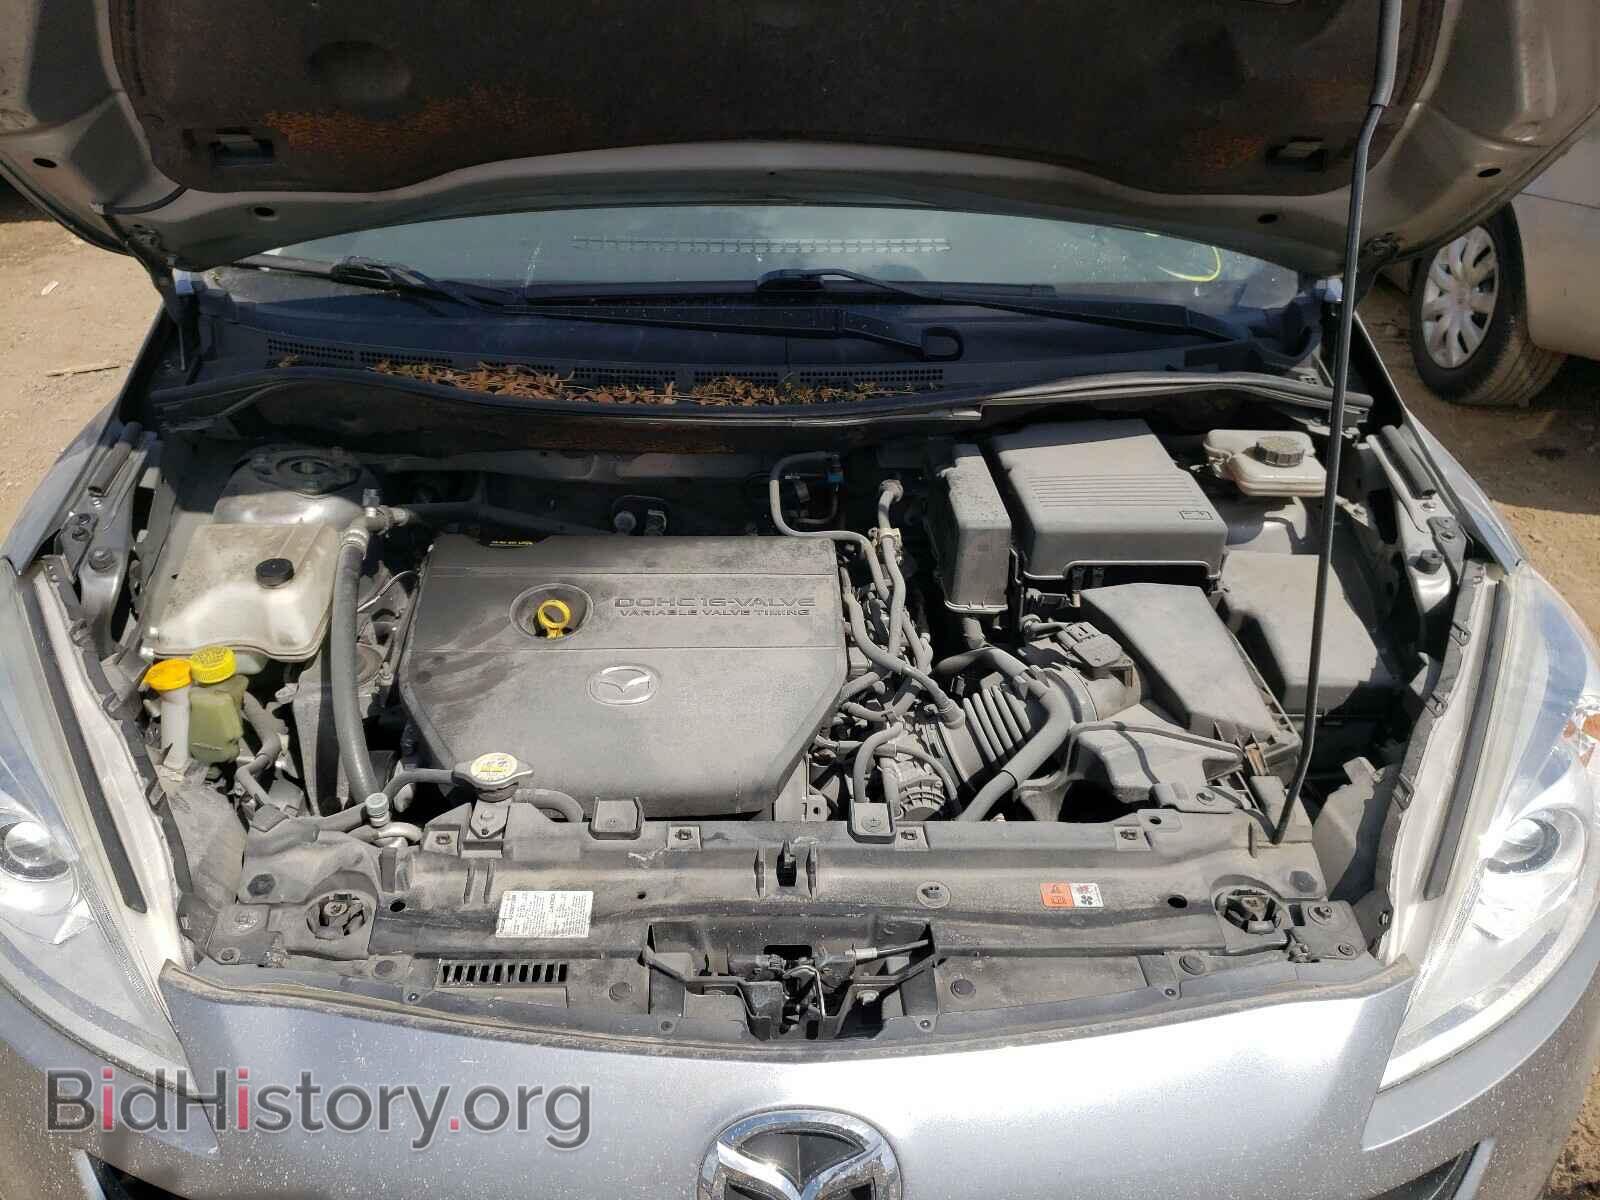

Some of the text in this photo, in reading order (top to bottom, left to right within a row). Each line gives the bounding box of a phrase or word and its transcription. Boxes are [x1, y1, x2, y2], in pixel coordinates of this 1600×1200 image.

[615, 597, 816, 608] DOHC 16-VALVE
[620, 609, 698, 617] VARIABLE
